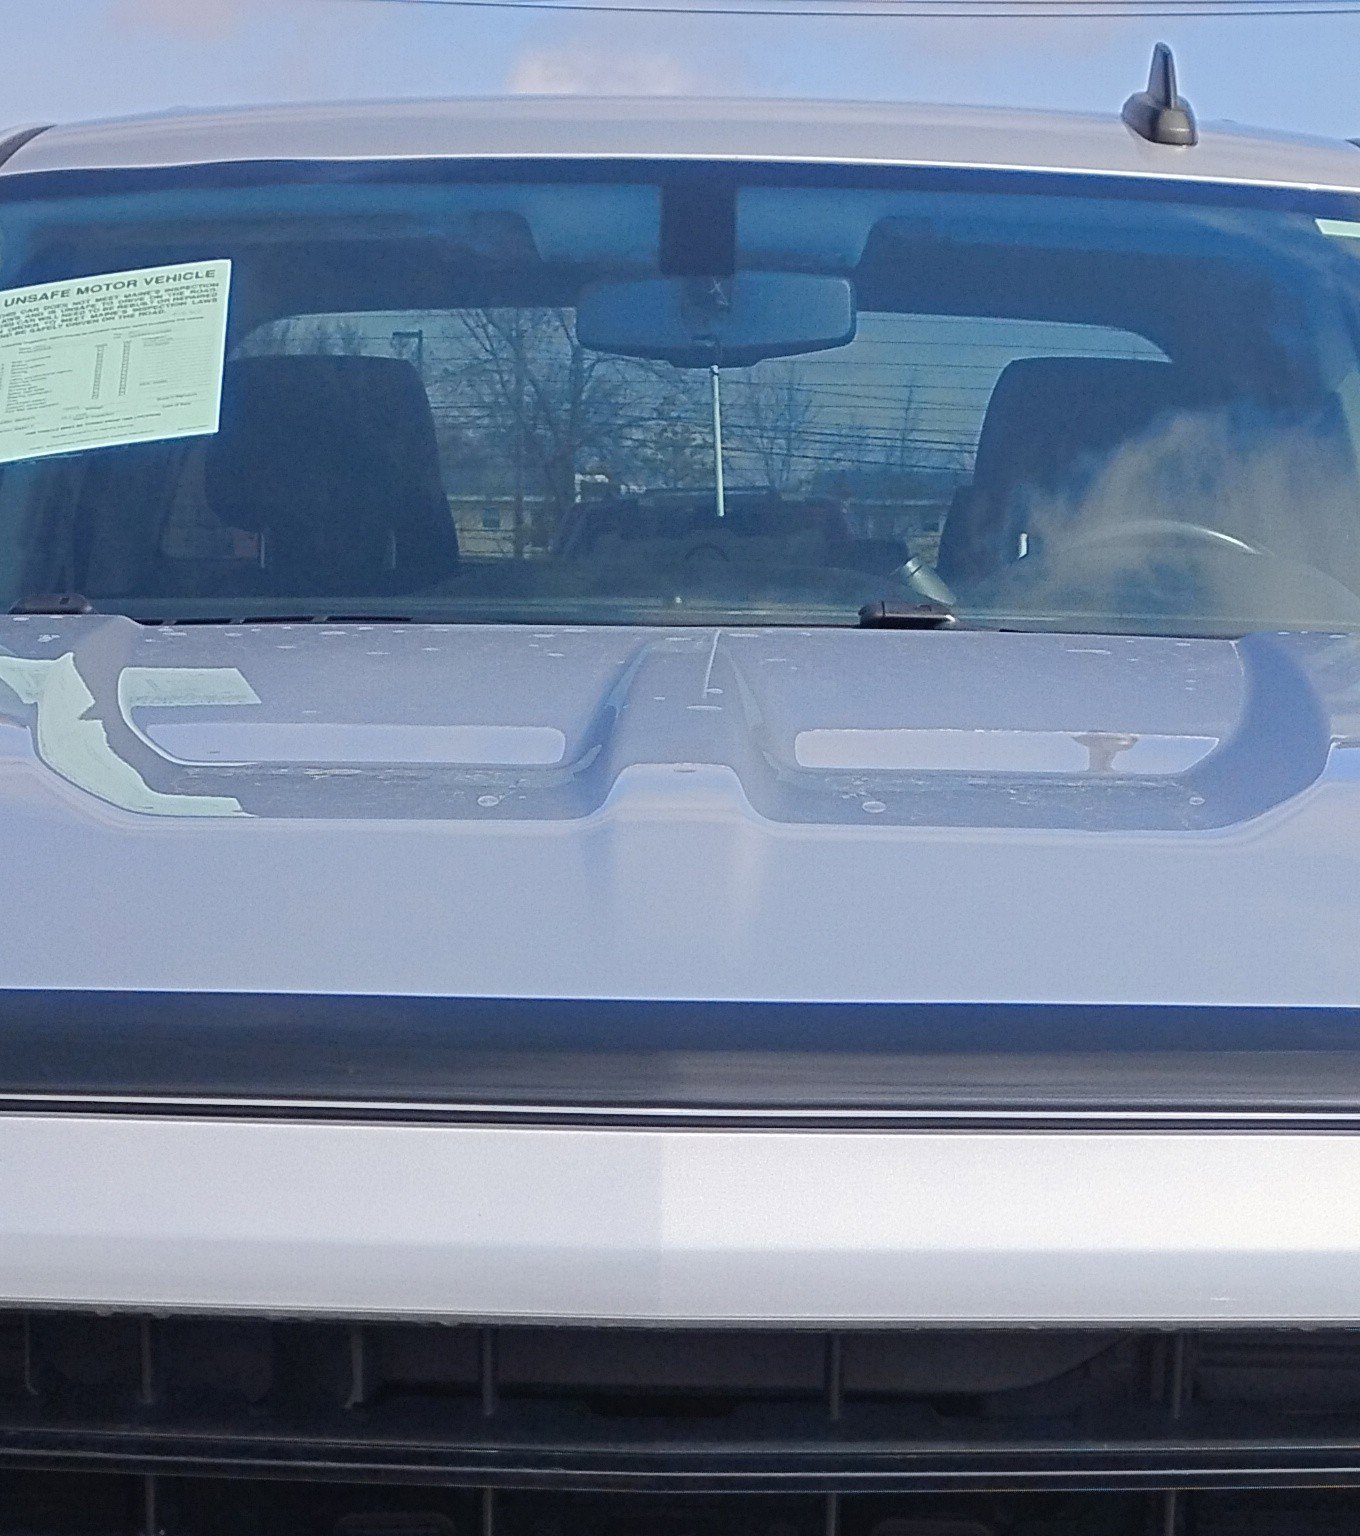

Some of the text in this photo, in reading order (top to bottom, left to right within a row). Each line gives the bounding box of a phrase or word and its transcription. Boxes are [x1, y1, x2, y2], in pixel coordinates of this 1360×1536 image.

[5, 270, 216, 308] UNSAFE MOTOR VEHICLE
